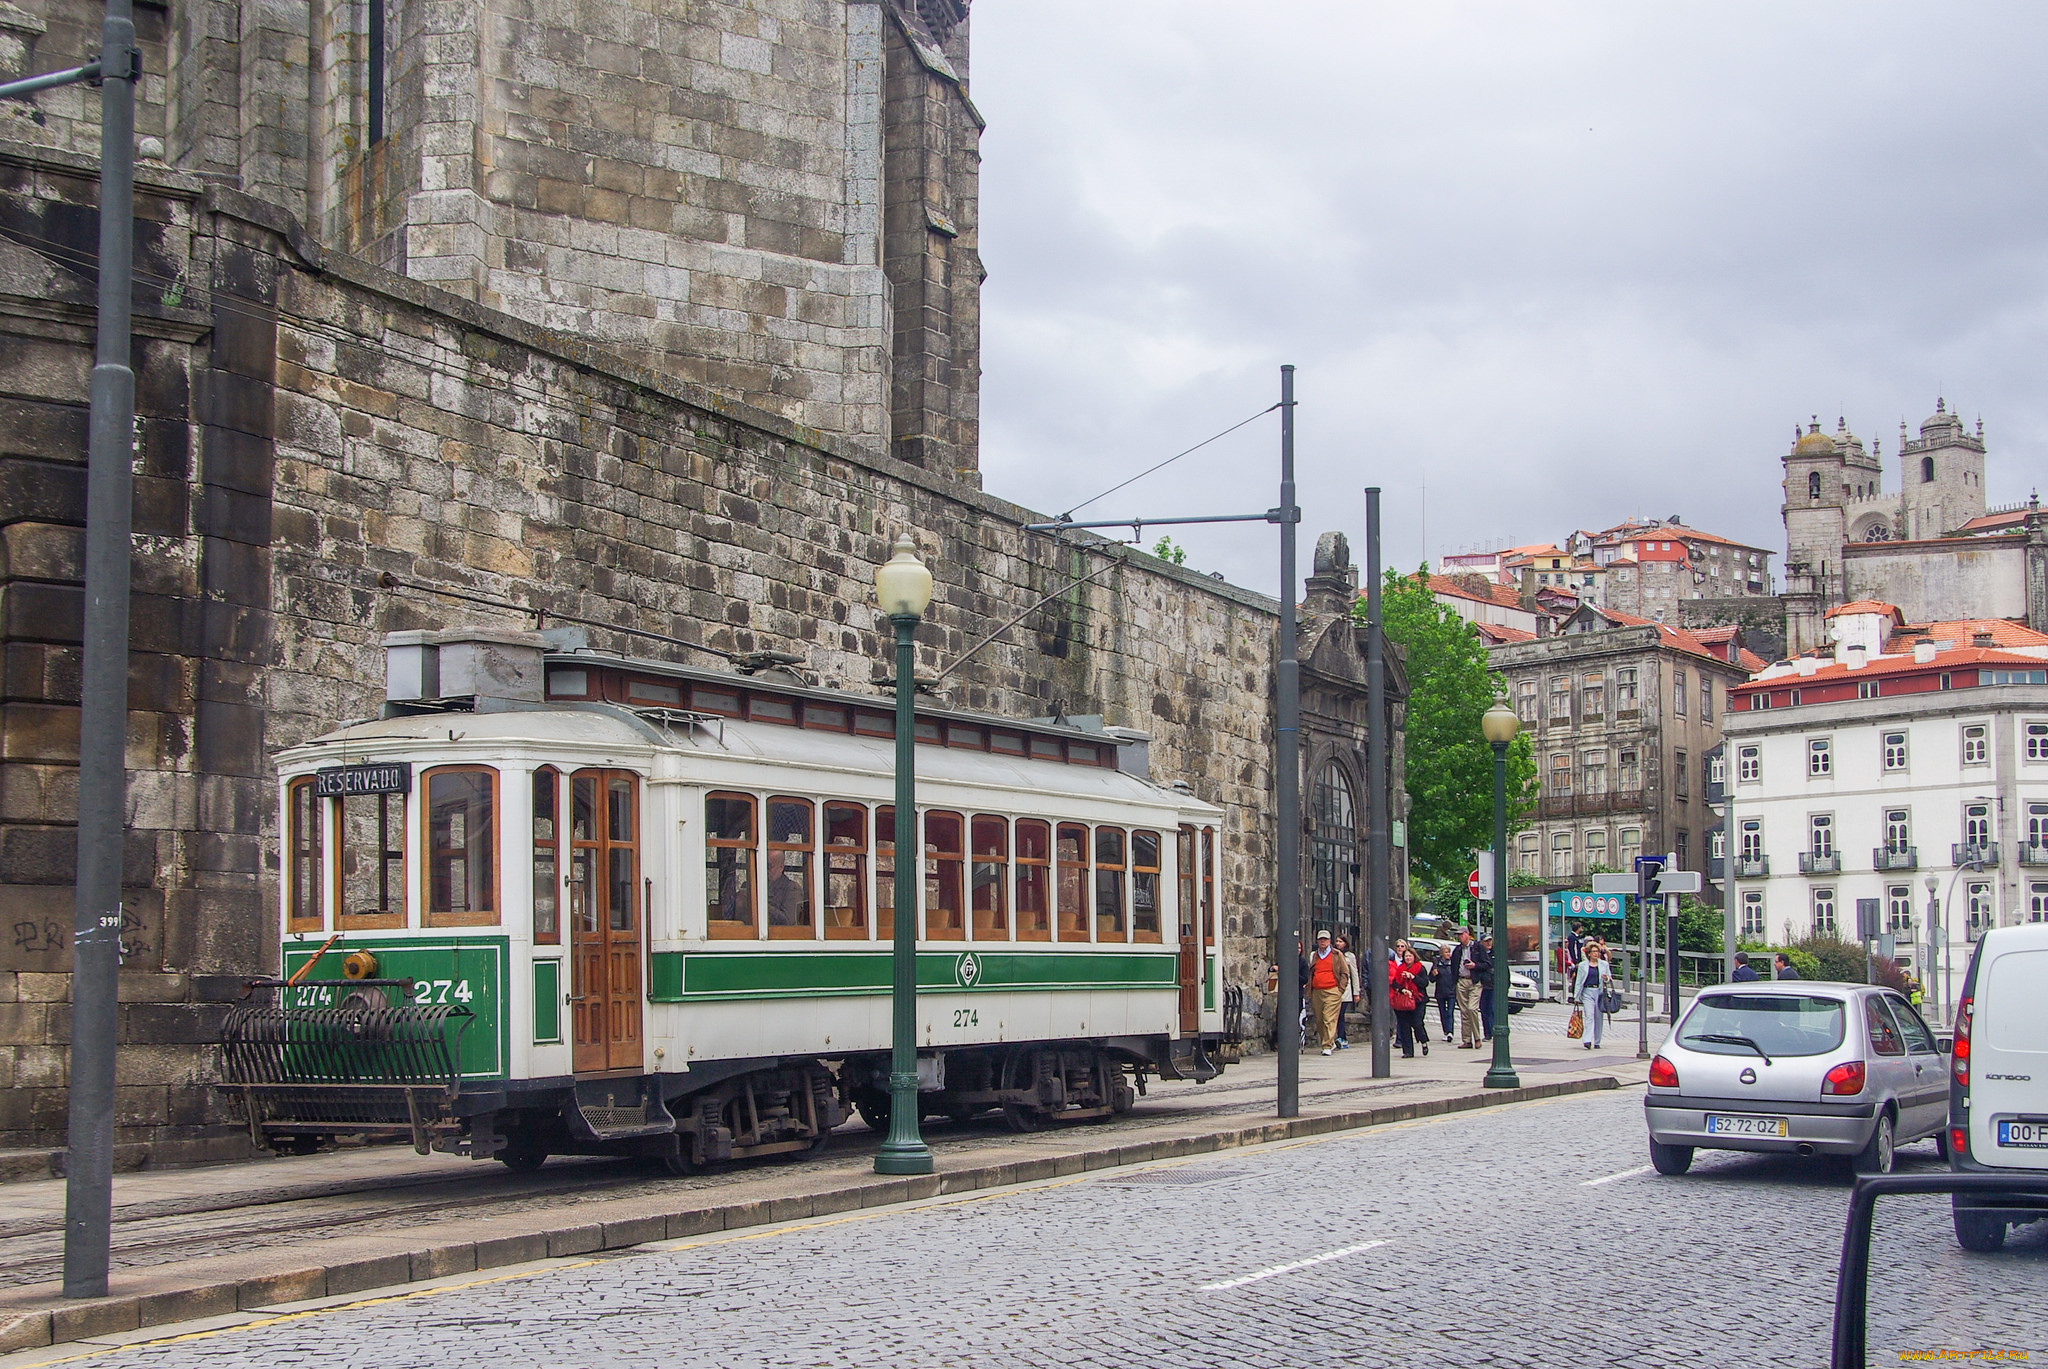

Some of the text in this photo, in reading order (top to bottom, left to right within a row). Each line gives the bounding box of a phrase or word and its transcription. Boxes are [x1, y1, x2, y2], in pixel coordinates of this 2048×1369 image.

[318, 769, 400, 793] RESERVADO
[99, 916, 119, 928] 399
[297, 985, 332, 1006] 274
[414, 980, 473, 1003] 274
[953, 1009, 978, 1027] 274
